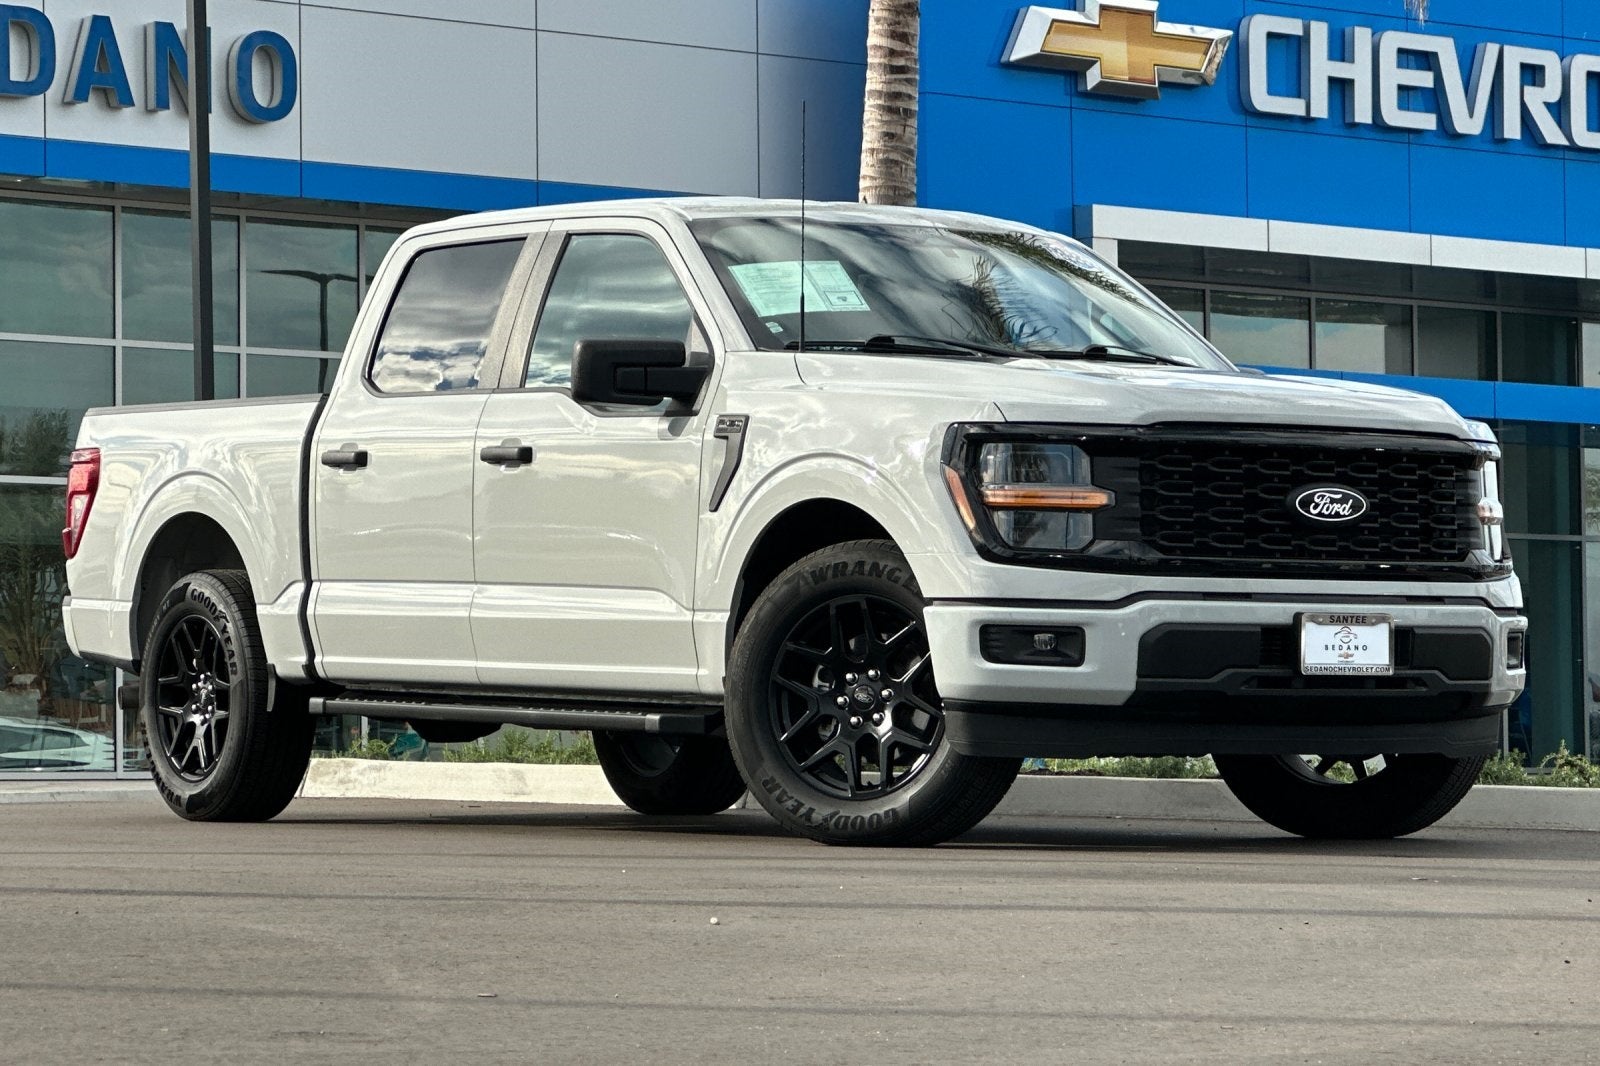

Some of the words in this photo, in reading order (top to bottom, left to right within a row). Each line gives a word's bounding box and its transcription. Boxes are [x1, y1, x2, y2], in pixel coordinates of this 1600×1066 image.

[1310, 492, 1353, 516] Ford
[1329, 614, 1367, 624] SANTEE
[1304, 665, 1391, 673] SEDANOCHEVROLET.COM
